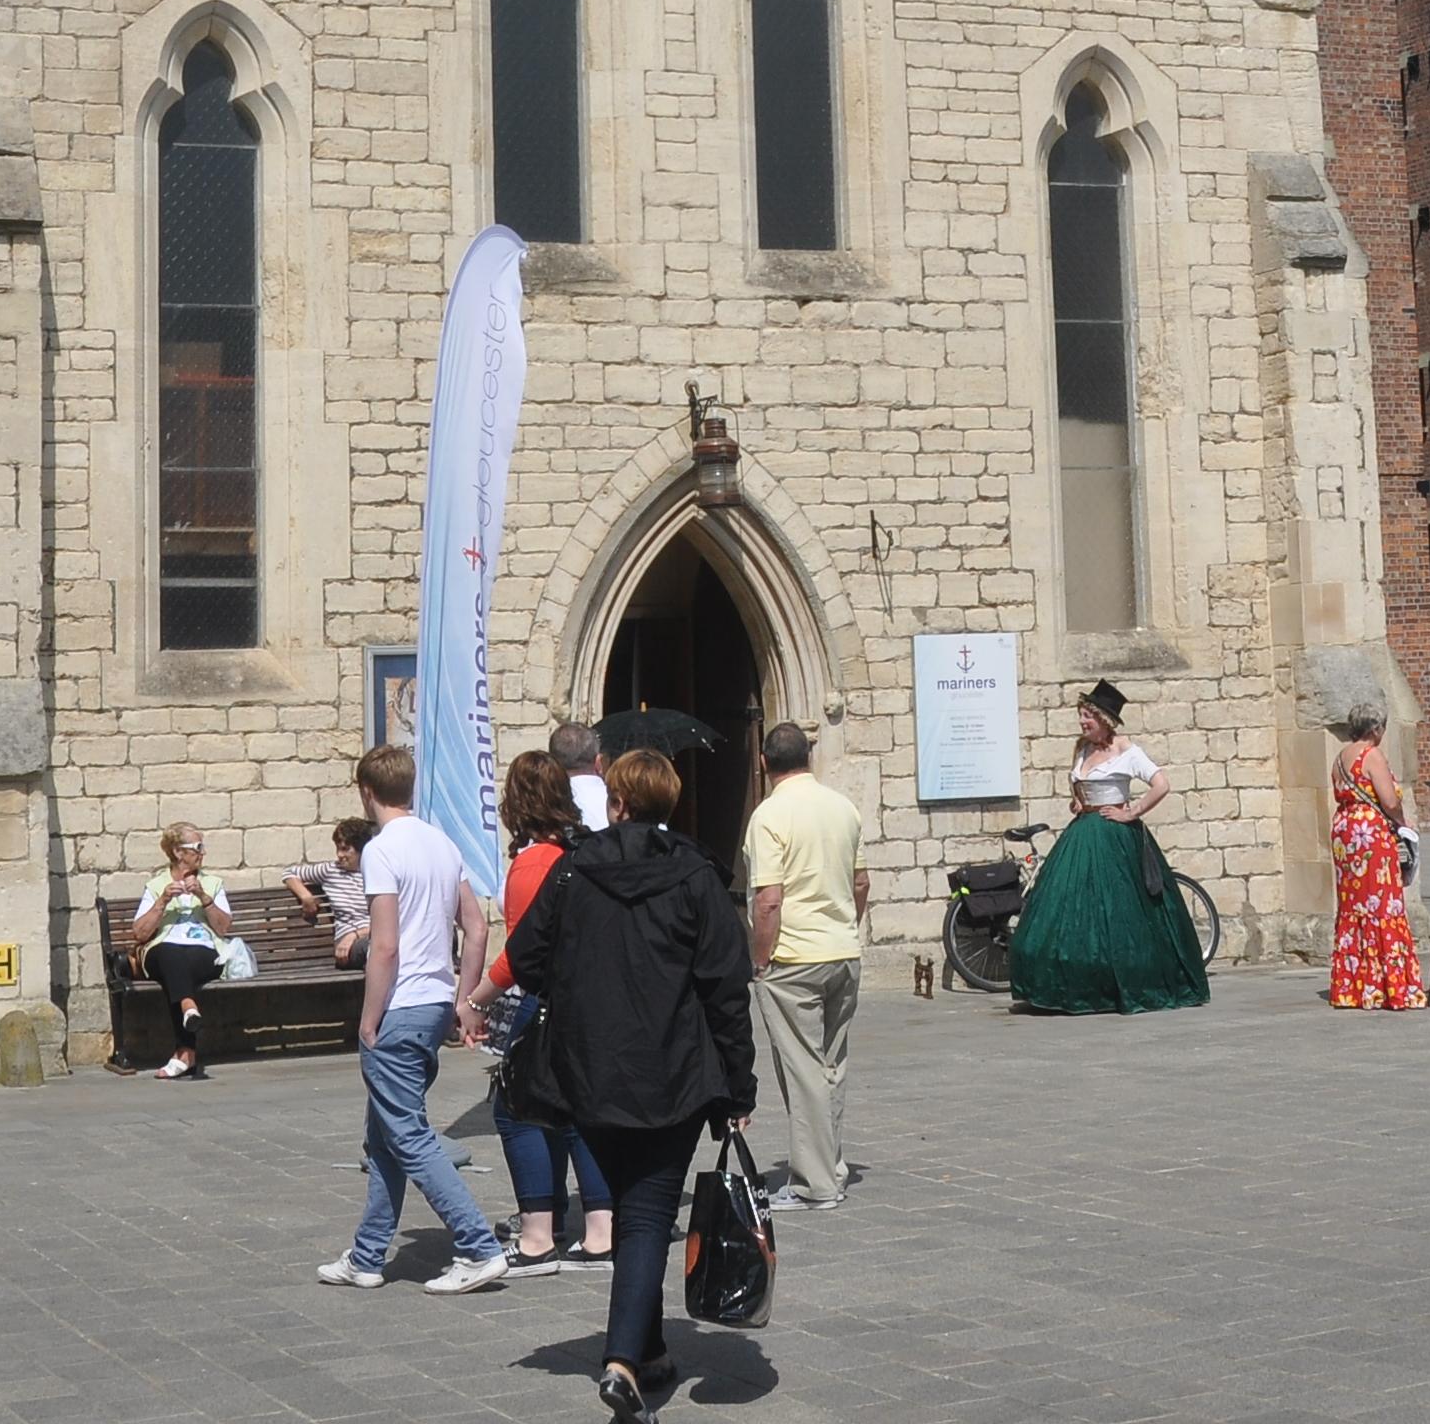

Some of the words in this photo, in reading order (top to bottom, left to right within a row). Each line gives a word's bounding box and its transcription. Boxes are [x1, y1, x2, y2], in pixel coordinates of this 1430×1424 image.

[473, 282, 507, 527] gloucester
[468, 592, 497, 833] mariners
[937, 676, 997, 691] mariners
